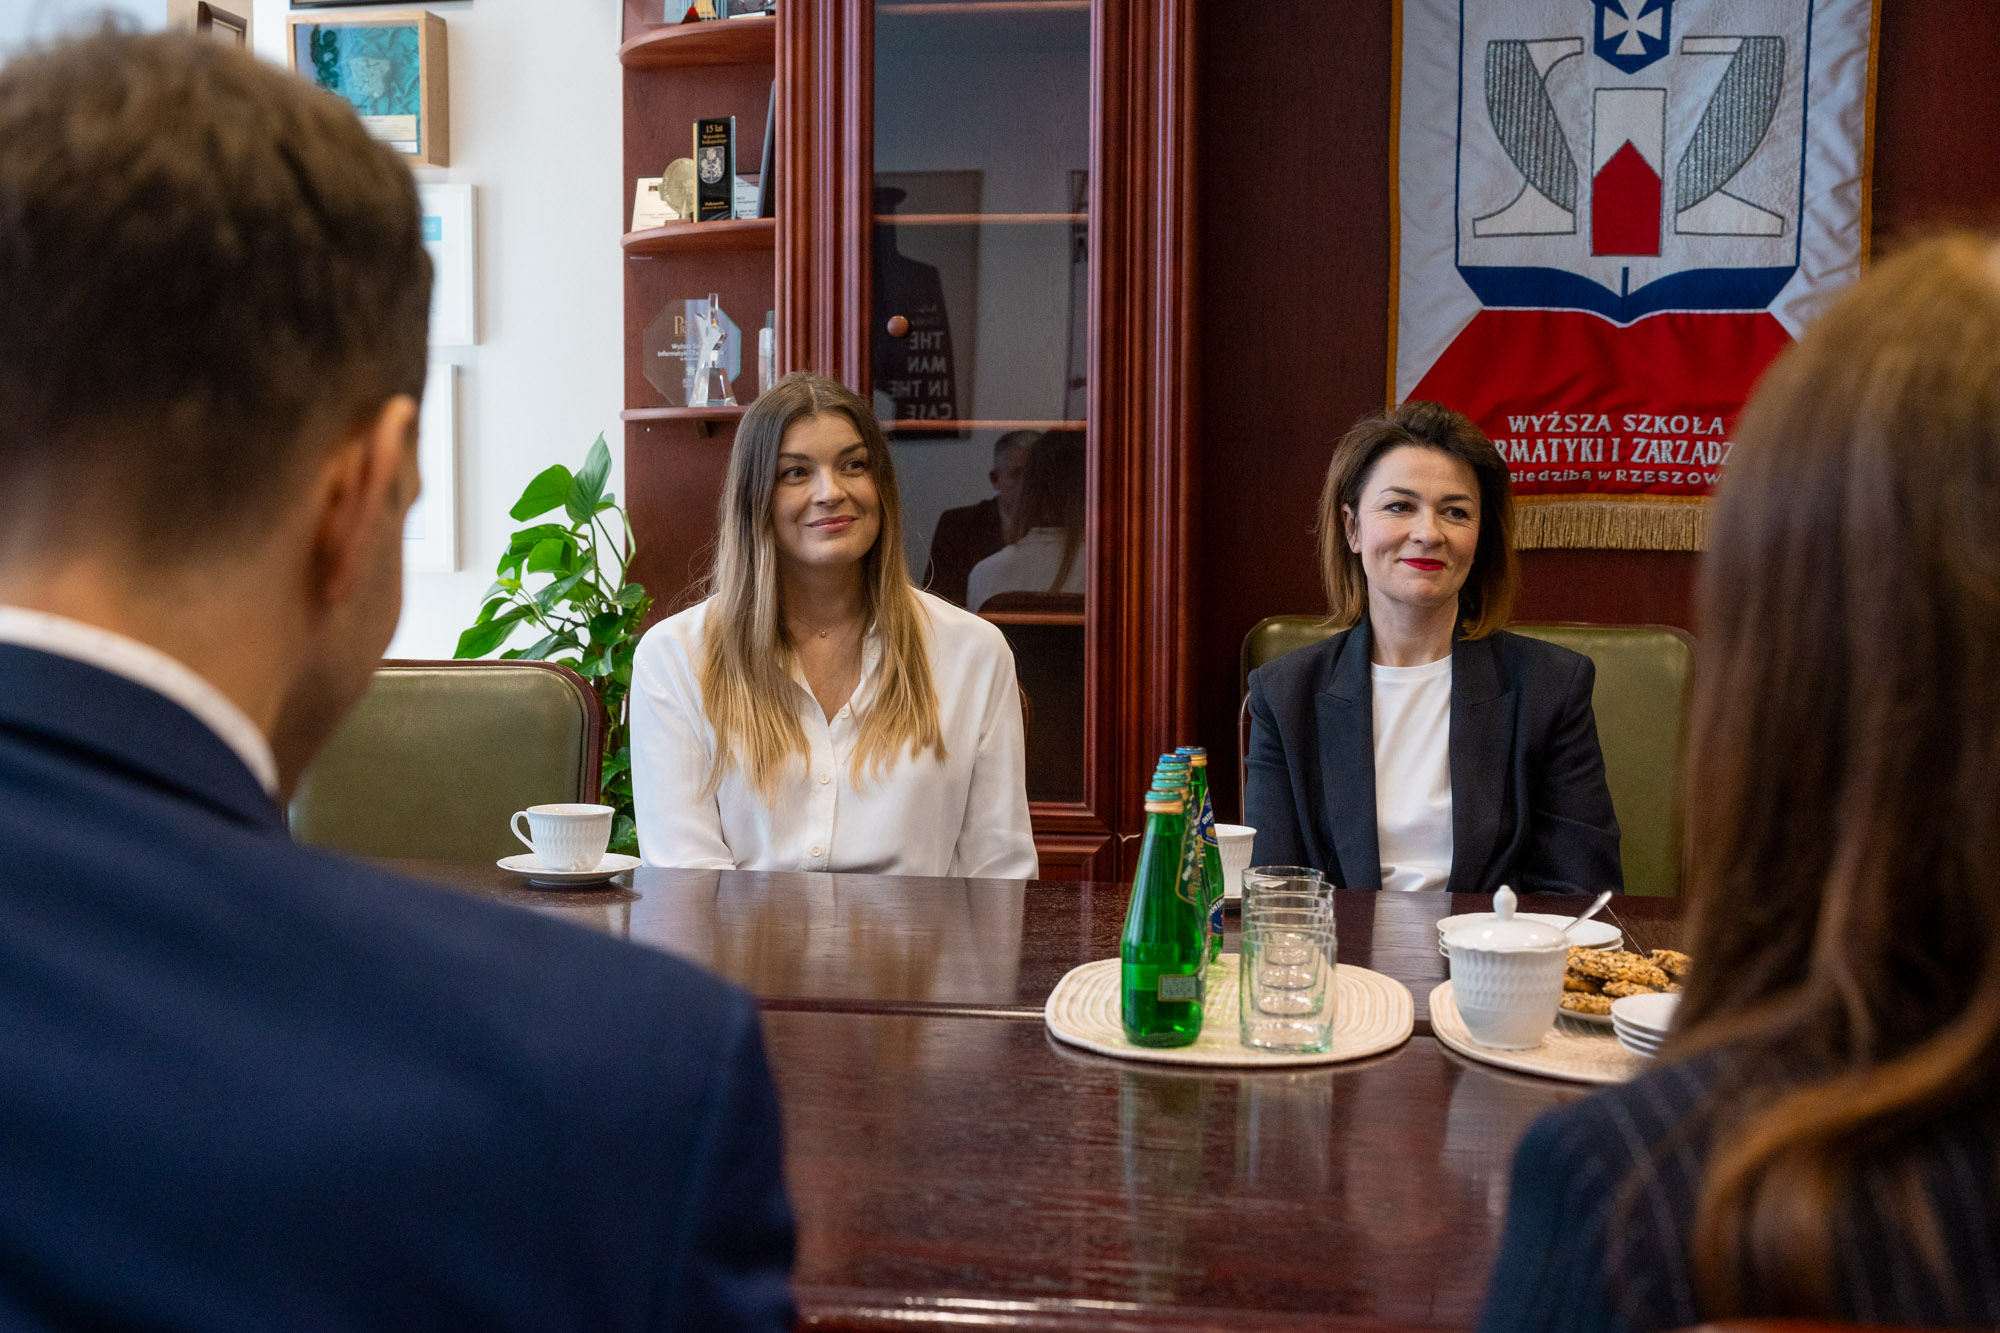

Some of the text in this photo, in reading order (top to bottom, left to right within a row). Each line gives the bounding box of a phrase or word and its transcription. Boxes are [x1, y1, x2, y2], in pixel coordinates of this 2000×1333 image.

[705, 124, 724, 134] 15 lat
[1507, 410, 1725, 435] WYŻSZA SZKOŁA
[1493, 437, 1604, 463] RMATYKI
[1611, 437, 1621, 463] I
